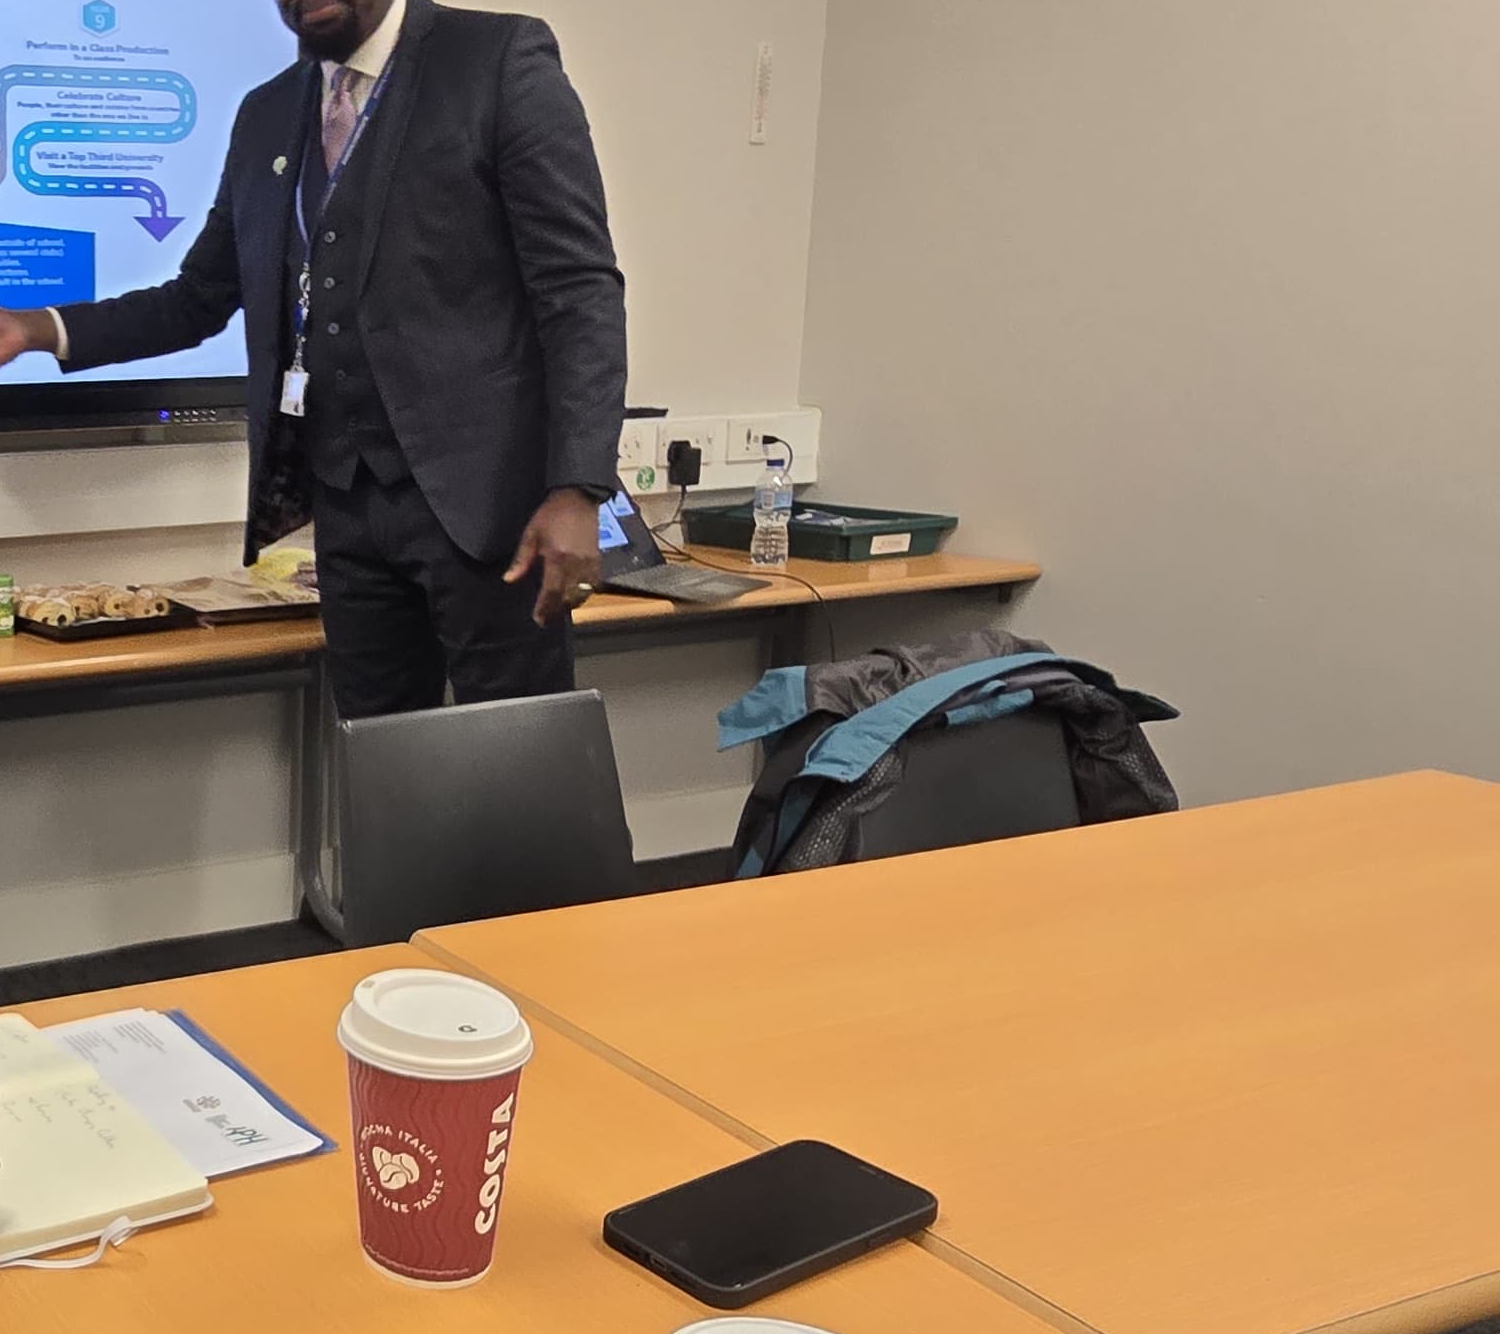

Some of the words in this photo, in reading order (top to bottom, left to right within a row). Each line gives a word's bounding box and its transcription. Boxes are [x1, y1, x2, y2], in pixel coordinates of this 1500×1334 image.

[94, 13, 105, 29] 9
[398, 1130, 438, 1164] ITALIA
[474, 1092, 514, 1235] COSTA
[413, 1179, 444, 1211] TASTE
